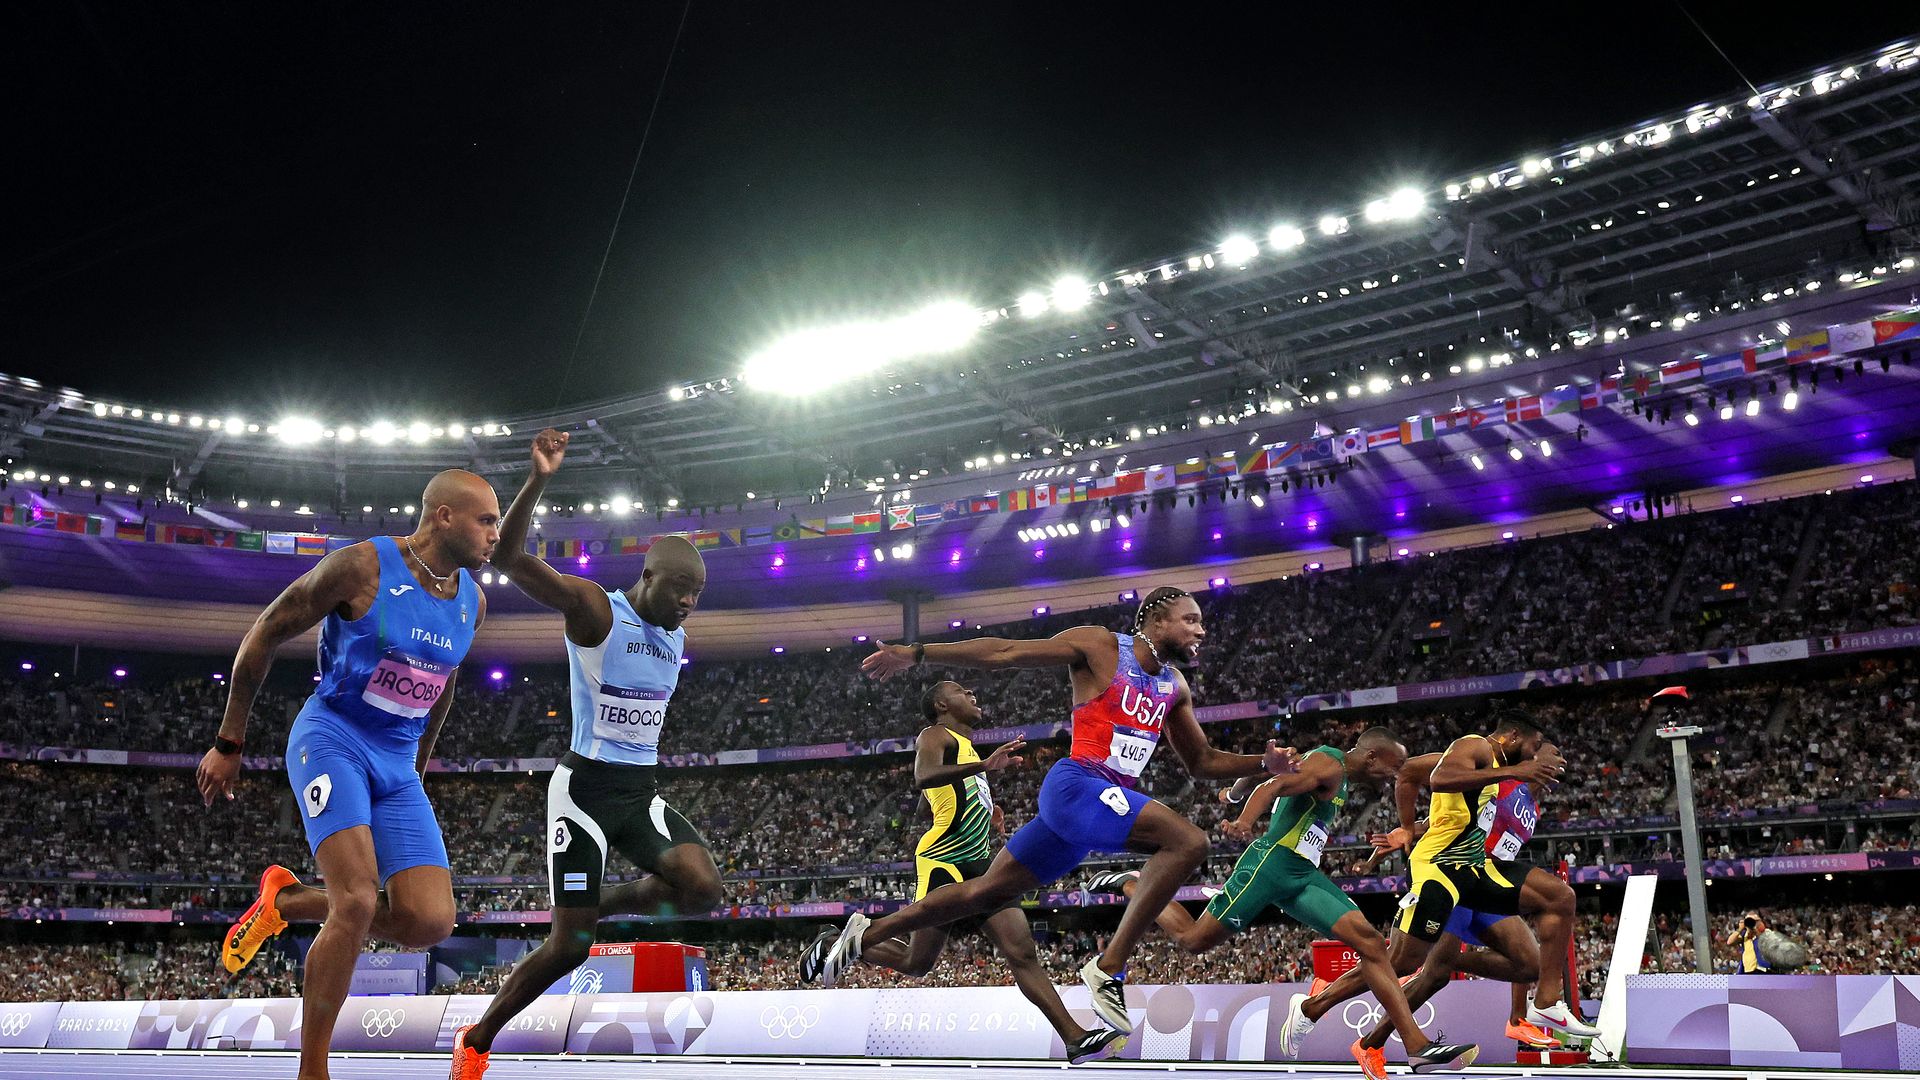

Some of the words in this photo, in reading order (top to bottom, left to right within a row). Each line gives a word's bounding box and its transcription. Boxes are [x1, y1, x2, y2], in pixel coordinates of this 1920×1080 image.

[411, 627, 453, 650] ITALIA
[1841, 635, 1886, 649] PARIS
[627, 642, 678, 666] BOTSWANA
[373, 667, 442, 702] JACOBS
[1421, 684, 1457, 696] PARIS
[1461, 680, 1493, 692] 2024
[600, 704, 662, 726] TEBOGO
[1121, 685, 1167, 729] USA
[311, 785, 322, 806] 9
[1513, 798, 1536, 837] USA
[554, 827, 565, 847] 8
[1769, 860, 1807, 870] PARIS
[1812, 859, 1848, 869] 2024
[1870, 858, 1886, 868] D4
[790, 906, 812, 914] PARIS
[607, 946, 632, 955] OMEGA
[58, 1018, 95, 1032] PARIS
[96, 1018, 129, 1032] 2024
[508, 1015, 558, 1032] 2024
[967, 1012, 1038, 1032] 2024
